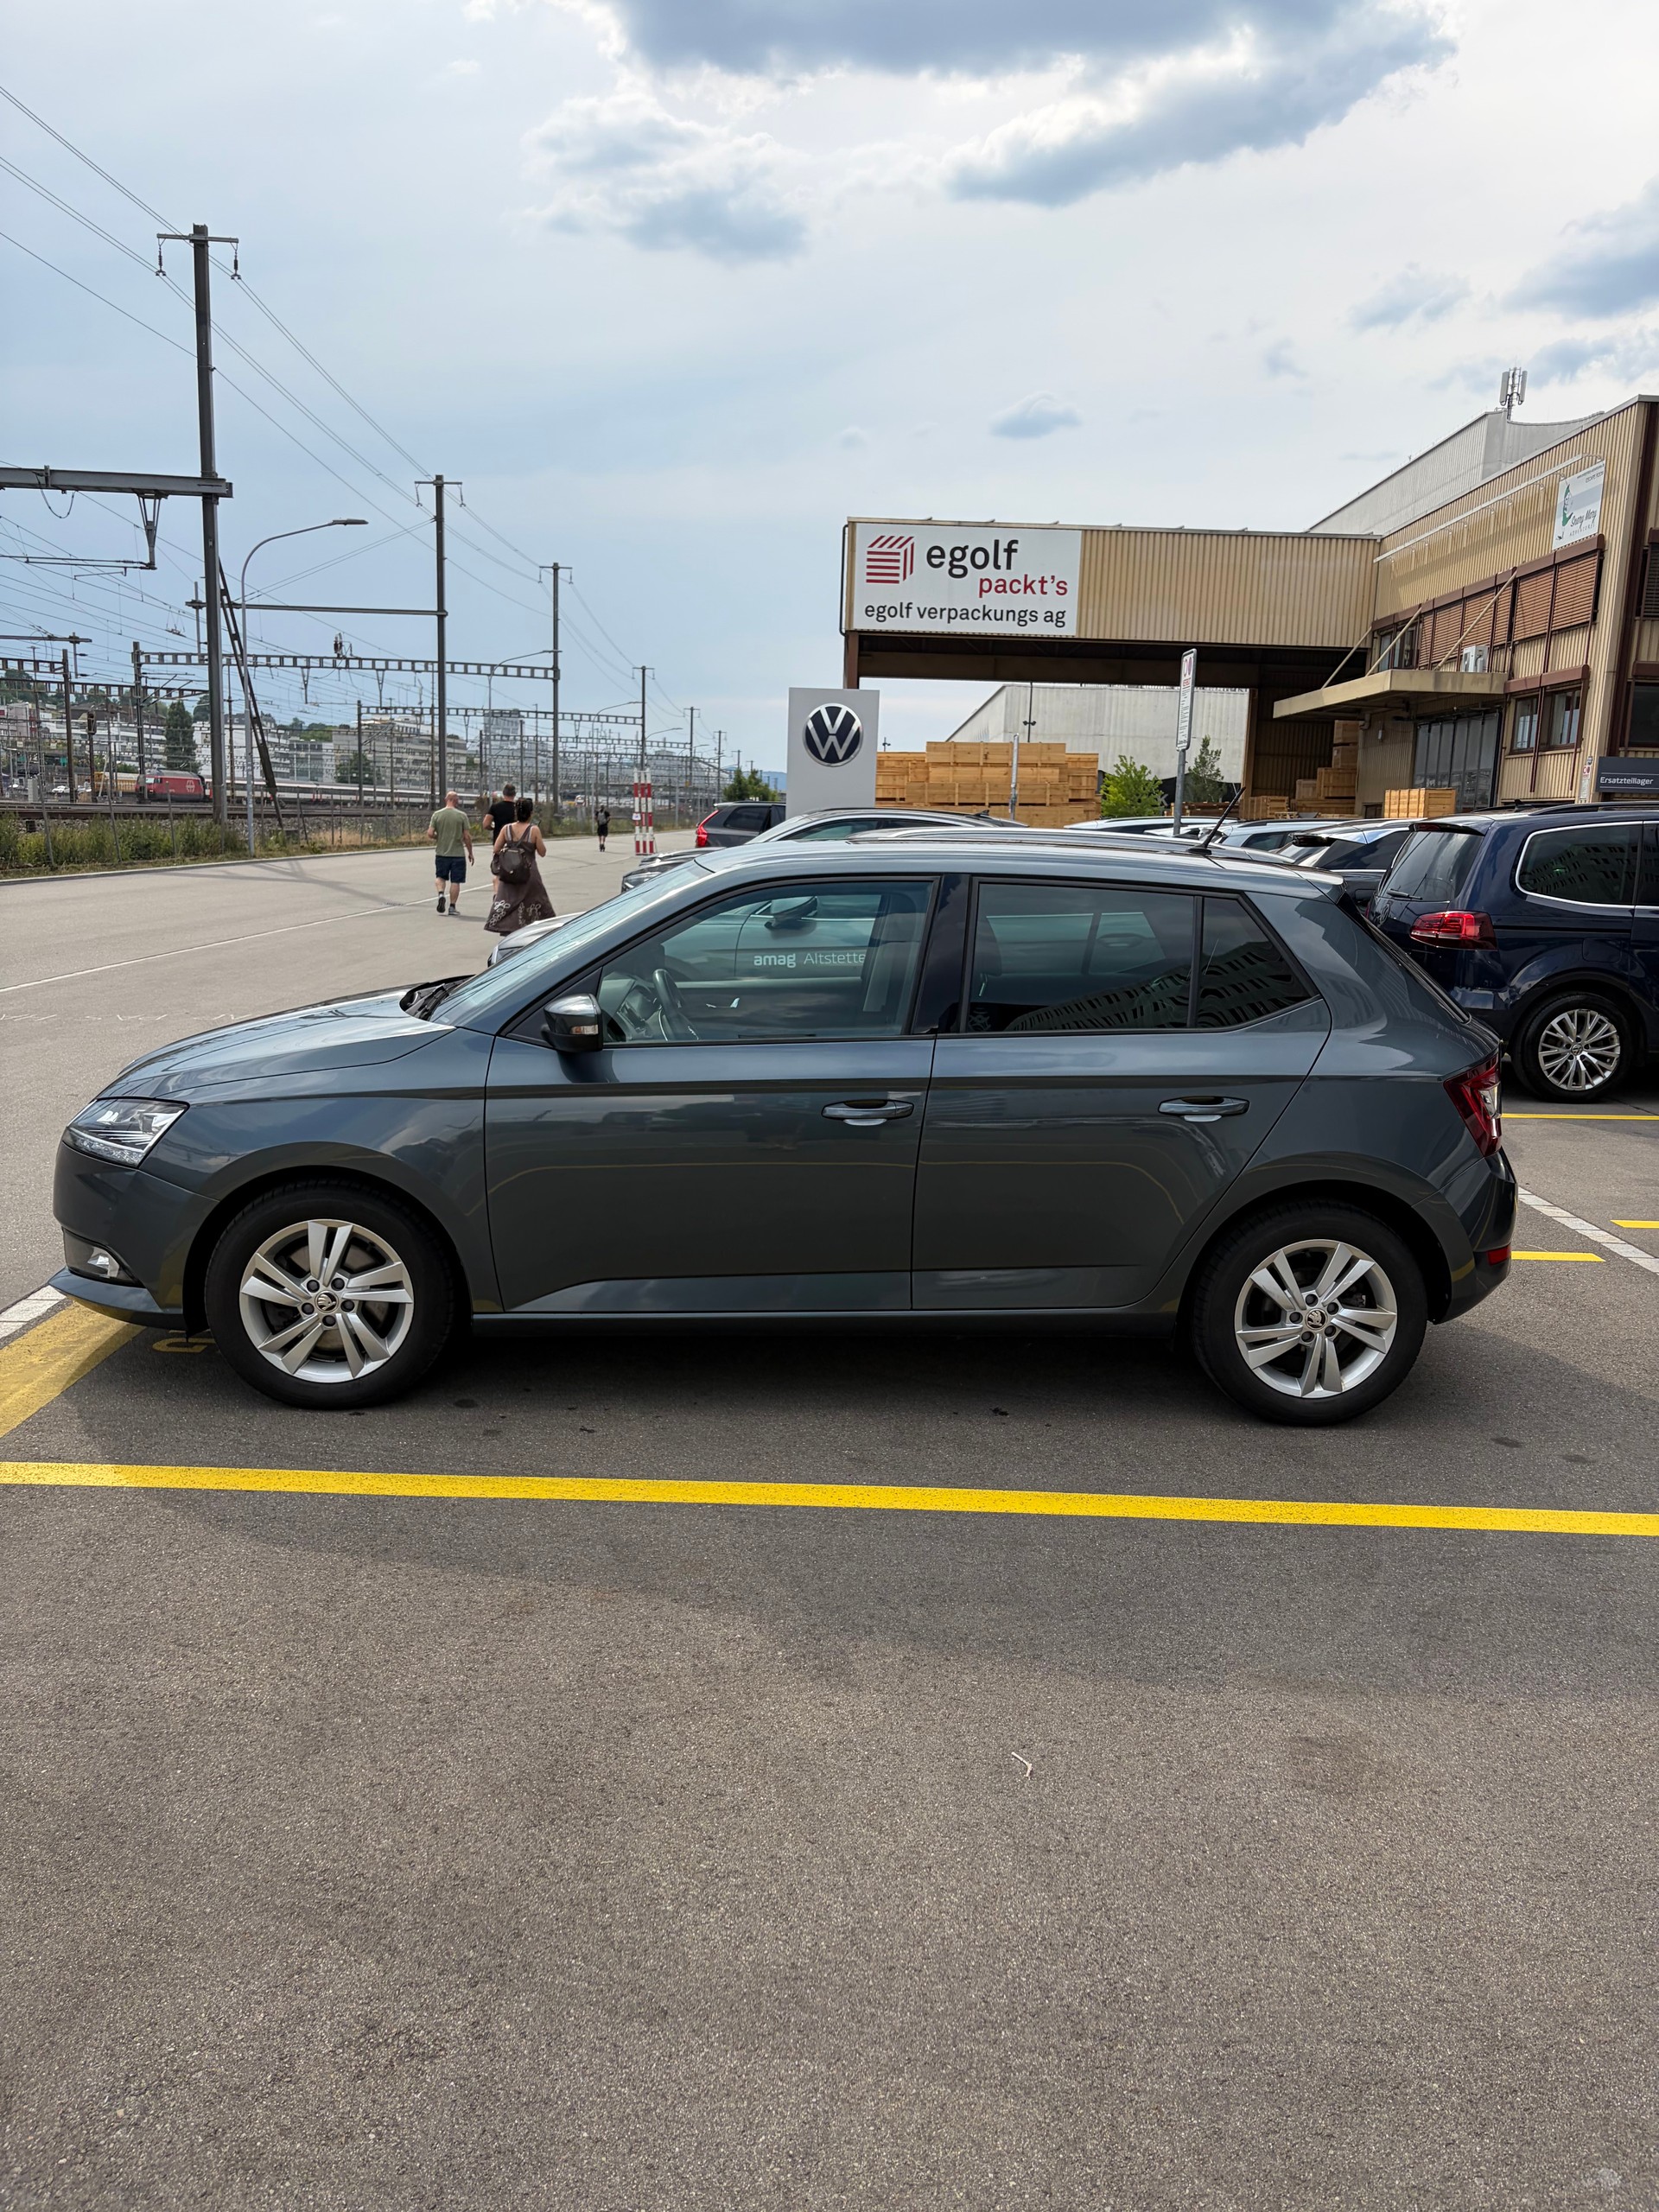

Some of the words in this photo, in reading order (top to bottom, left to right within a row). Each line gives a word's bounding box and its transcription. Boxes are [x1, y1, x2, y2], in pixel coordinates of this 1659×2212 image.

[925, 538, 1020, 579] egolf
[978, 574, 1068, 599] packt's
[864, 601, 912, 623] egolf
[917, 604, 1039, 628] verpackungs
[1043, 608, 1066, 628] ag
[805, 704, 861, 762] VW
[1599, 776, 1654, 786] Ersatzteillager
[753, 953, 797, 968] amag
